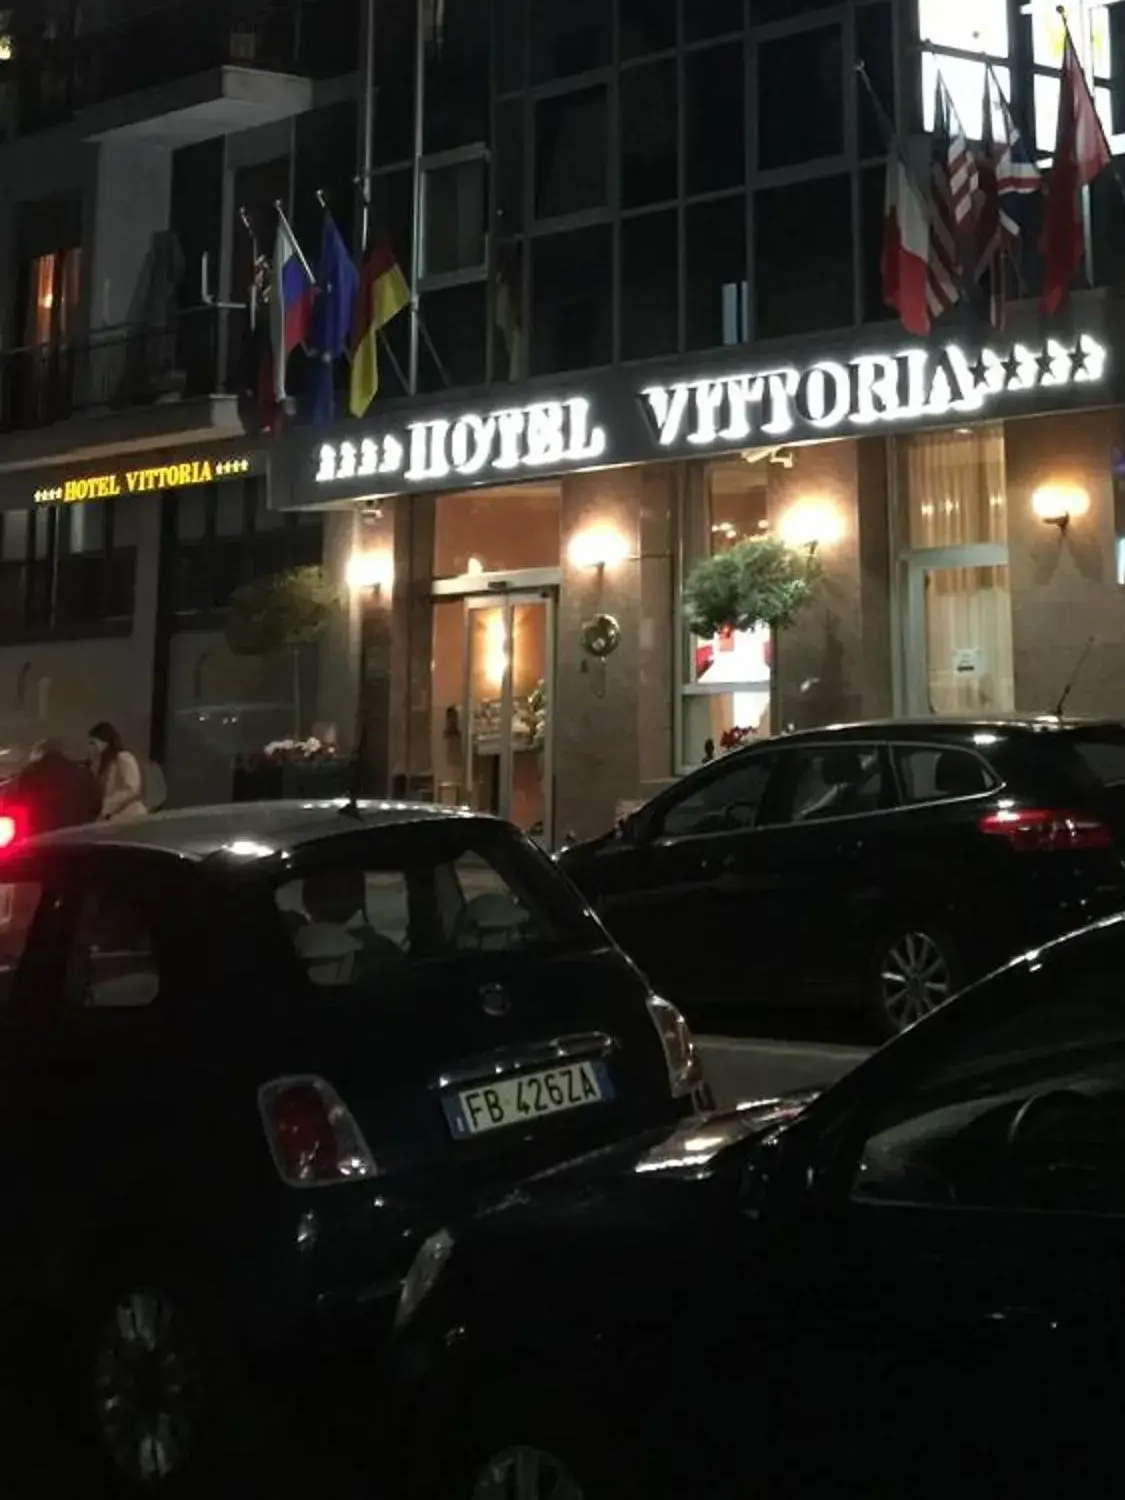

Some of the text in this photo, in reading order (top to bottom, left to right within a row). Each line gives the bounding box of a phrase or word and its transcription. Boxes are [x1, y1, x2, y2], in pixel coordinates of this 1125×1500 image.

[402, 343, 984, 482] HOTEL VITTORIA
[63, 458, 213, 503] HOTEL VITTORIA
[464, 1065, 598, 1130] FB 426ZA
